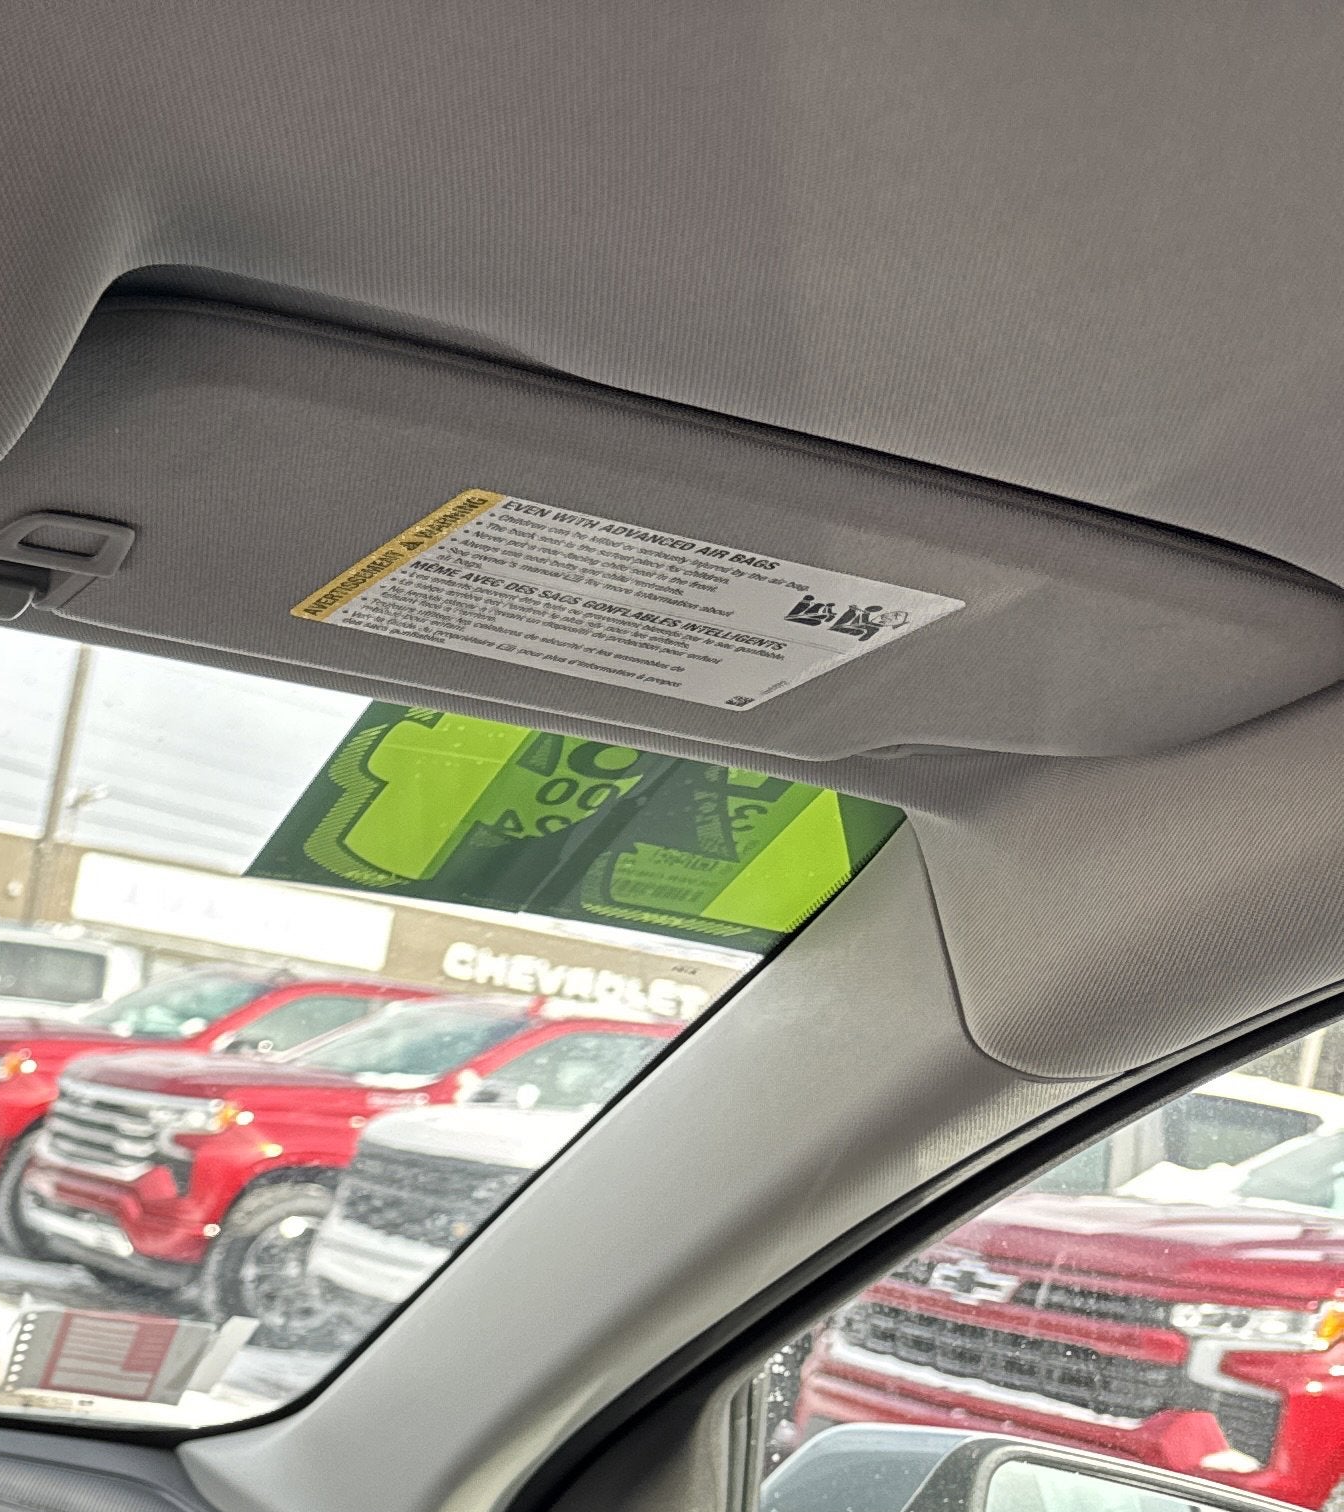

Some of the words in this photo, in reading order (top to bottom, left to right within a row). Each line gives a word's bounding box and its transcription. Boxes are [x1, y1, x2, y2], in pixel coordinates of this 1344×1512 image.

[501, 501, 551, 517] EVEN
[550, 512, 600, 528] WITH
[598, 524, 697, 550] ADVANCED
[694, 546, 731, 558] AIR
[727, 554, 781, 570] BAGS
[408, 559, 461, 576] MÊME
[459, 573, 505, 586] AVEC
[503, 583, 539, 594] DES
[536, 590, 583, 604] SACS
[580, 600, 683, 626] GONFLABLES
[679, 623, 787, 650] INTELLIGENTS
[442, 941, 710, 1020] CHEVROLET
